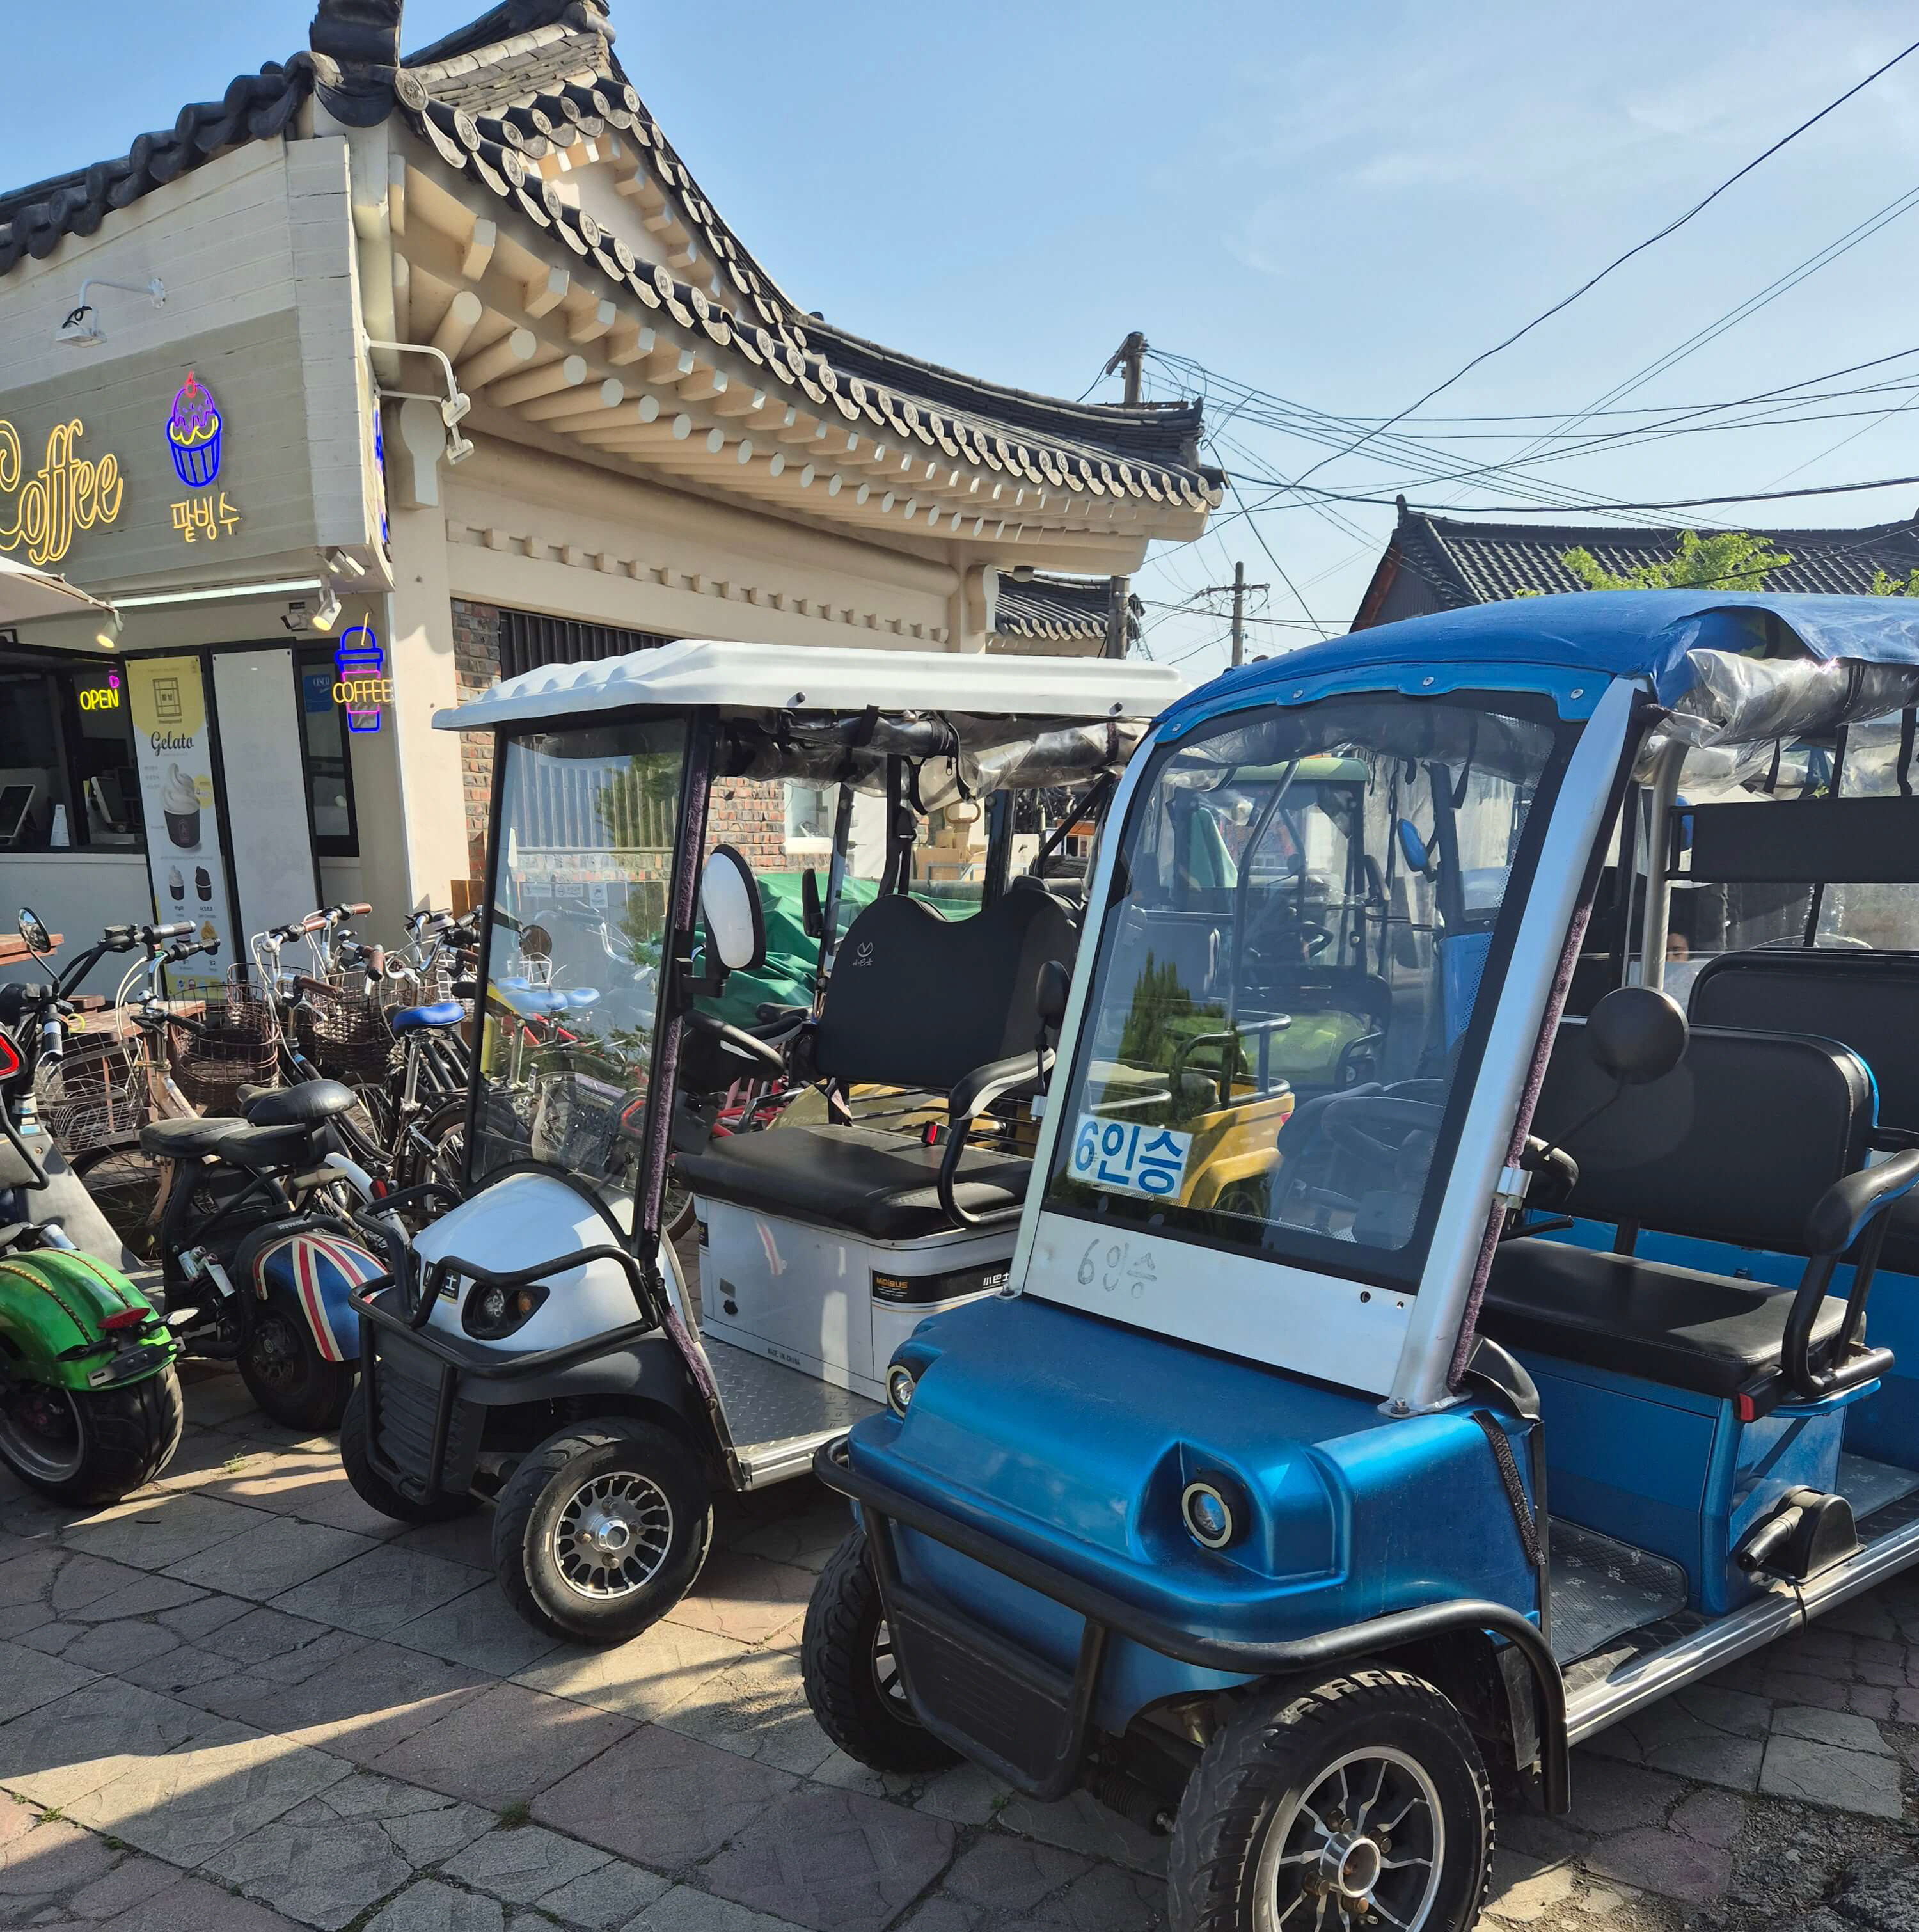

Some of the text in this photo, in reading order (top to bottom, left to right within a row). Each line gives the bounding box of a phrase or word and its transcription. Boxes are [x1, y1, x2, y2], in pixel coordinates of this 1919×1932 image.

[170, 491, 240, 542] 팥빙수
[80, 689, 119, 711] OPEN
[333, 679, 393, 703] COFFEE
[151, 731, 194, 757] Gelato
[1075, 1121, 1183, 1194] 6인승
[1077, 1238, 1157, 1299] 6인승
